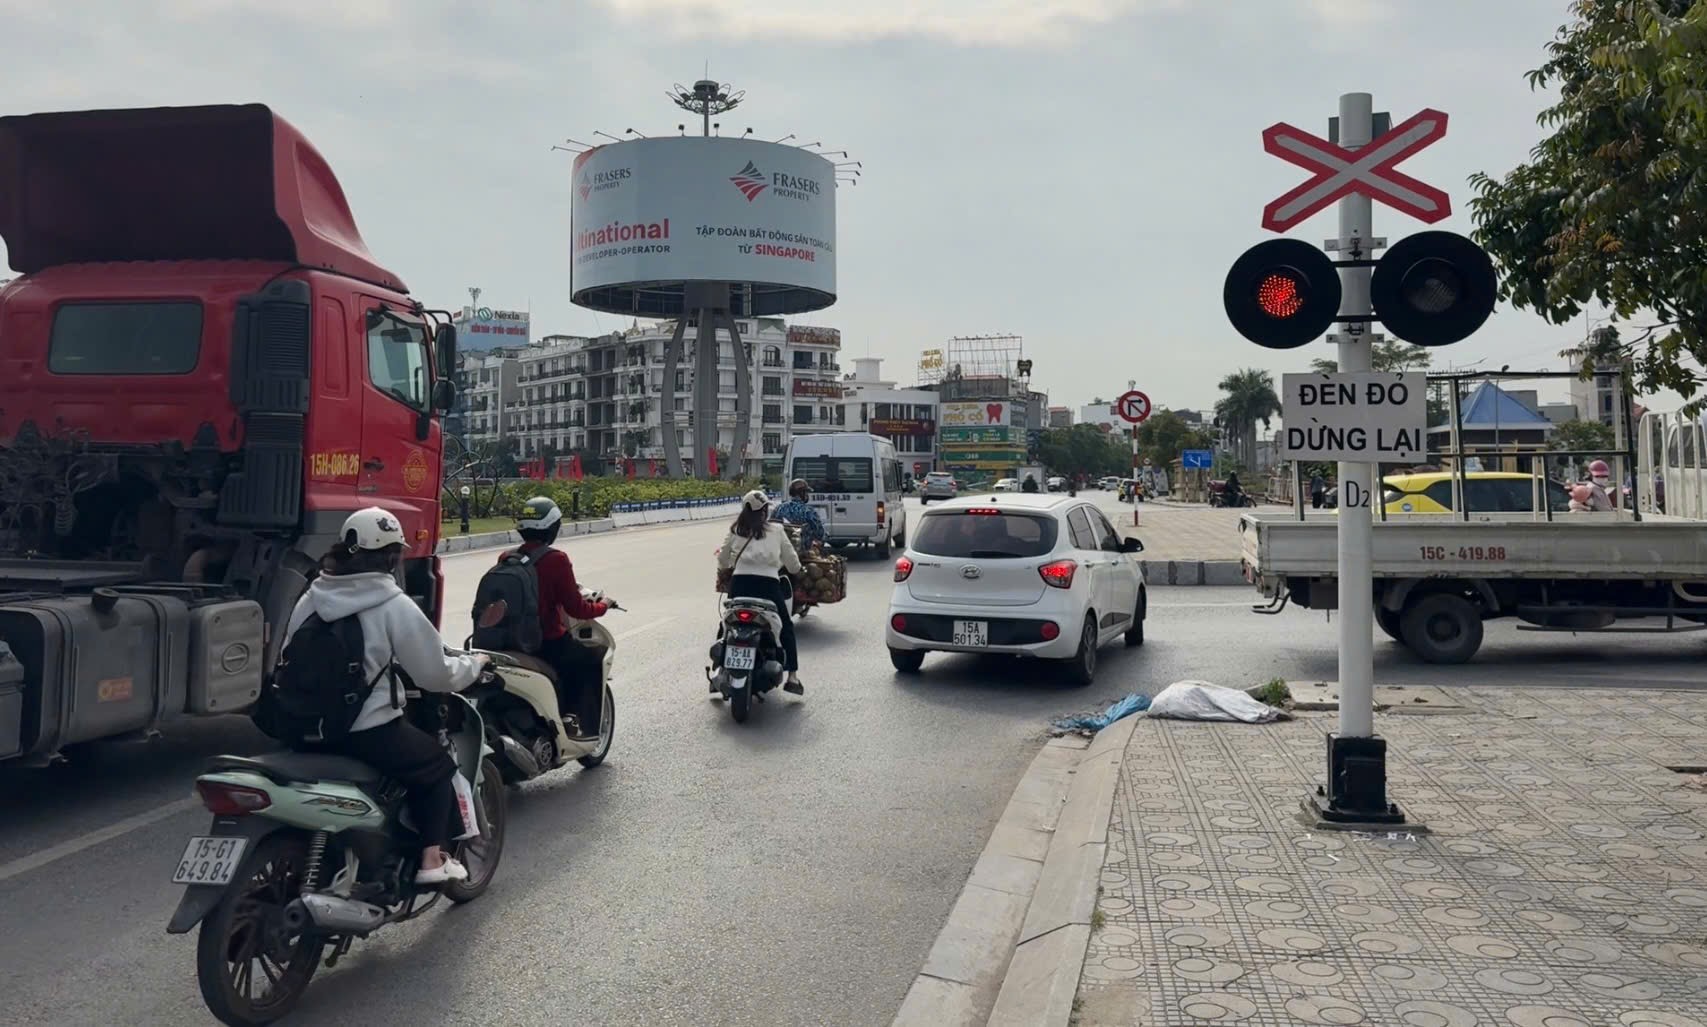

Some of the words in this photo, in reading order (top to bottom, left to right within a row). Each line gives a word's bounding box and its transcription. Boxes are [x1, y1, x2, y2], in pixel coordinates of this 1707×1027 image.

[594, 168, 631, 184] FRASERS
[773, 172, 820, 195] FRASERS
[594, 181, 620, 192] PROPERTY
[773, 187, 809, 201] PROPERTY
[696, 225, 715, 238] TẬP
[717, 226, 747, 237] ĐOÀN
[749, 227, 767, 238] BẤT
[768, 230, 793, 243] ĐỘNG
[738, 243, 752, 254] TỪ
[755, 244, 815, 262] SINGAPORE
[1298, 374, 1356, 406] ĐÈN
[1366, 373, 1409, 406] ĐỎ
[1288, 418, 1367, 451] DỪNG
[1377, 428, 1421, 457] LẠI
[1420, 546, 1445, 560] 15C
[1458, 546, 1506, 560] 419.88
[963, 622, 980, 634] 15A
[194, 839, 236, 859] 15-G1
[176, 860, 232, 881] 649.84
